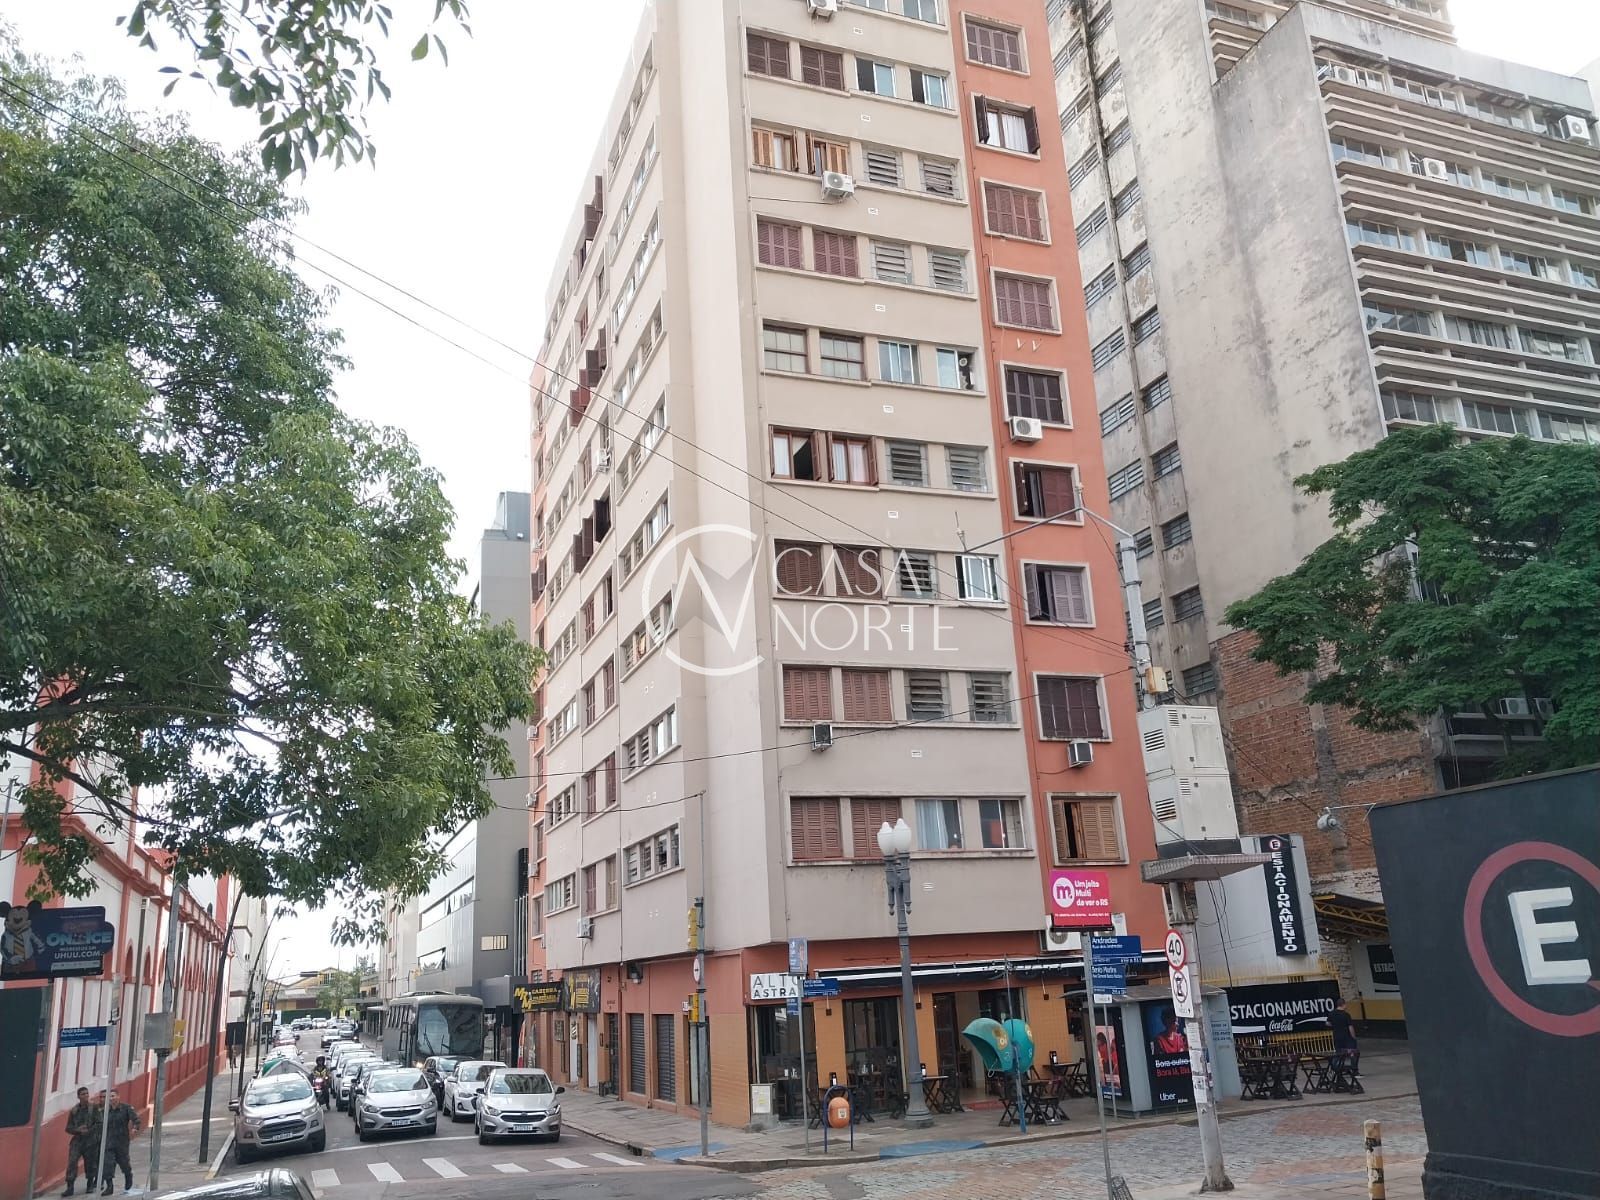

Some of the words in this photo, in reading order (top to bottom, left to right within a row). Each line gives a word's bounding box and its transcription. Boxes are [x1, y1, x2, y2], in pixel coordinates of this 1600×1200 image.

[1271, 852, 1298, 951] ESTACIONAMENTO
[1168, 939, 1182, 956] 40
[1507, 886, 1592, 986] E
[1159, 1092, 1177, 1101] Uber
